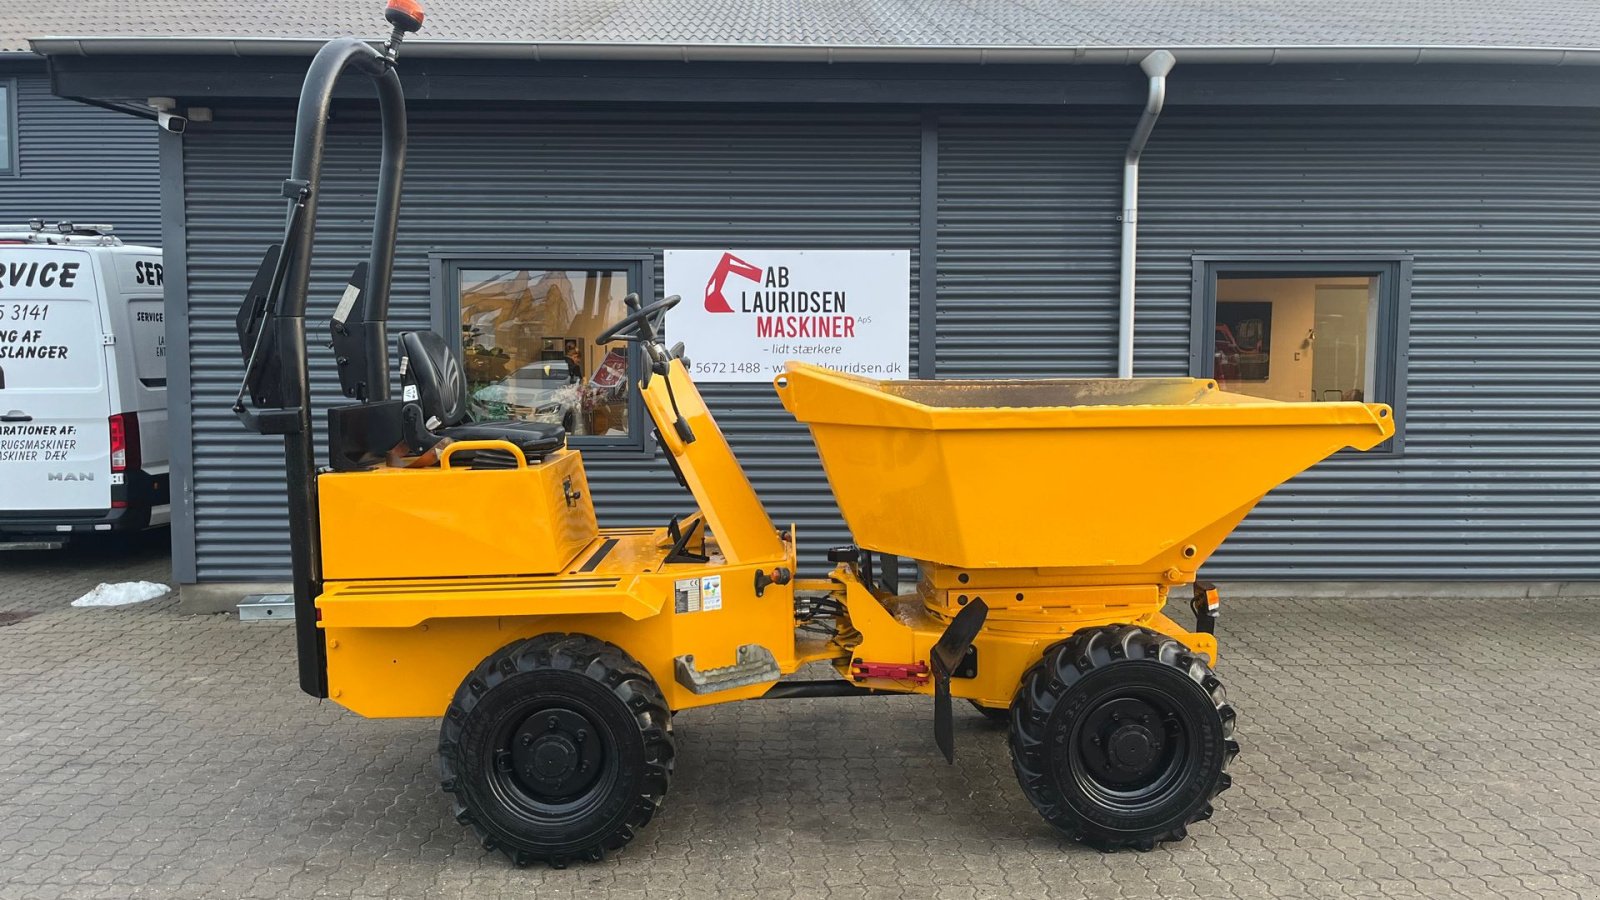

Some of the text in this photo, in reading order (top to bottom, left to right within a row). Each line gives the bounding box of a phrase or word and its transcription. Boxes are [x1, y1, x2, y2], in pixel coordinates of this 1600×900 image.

[765, 266, 789, 288] AB
[742, 291, 846, 313] LAURIDSEN
[11, 304, 49, 320] 3141
[136, 312, 163, 322] SERVICE
[757, 316, 872, 338] MASKINER ApS
[22, 330, 42, 343] AF
[0, 346, 68, 359] SLANGER
[772, 344, 790, 354] lidt
[792, 344, 842, 354] stærkere
[696, 362, 726, 373] 5672
[730, 362, 761, 373] 1488
[773, 363, 901, 373] wlauridsen.dk
[0, 426, 77, 436] RATIONER AF:
[1, 440, 77, 450] RUGSMASKINER
[45, 451, 68, 461] DÆK
[48, 472, 95, 481] MAN
